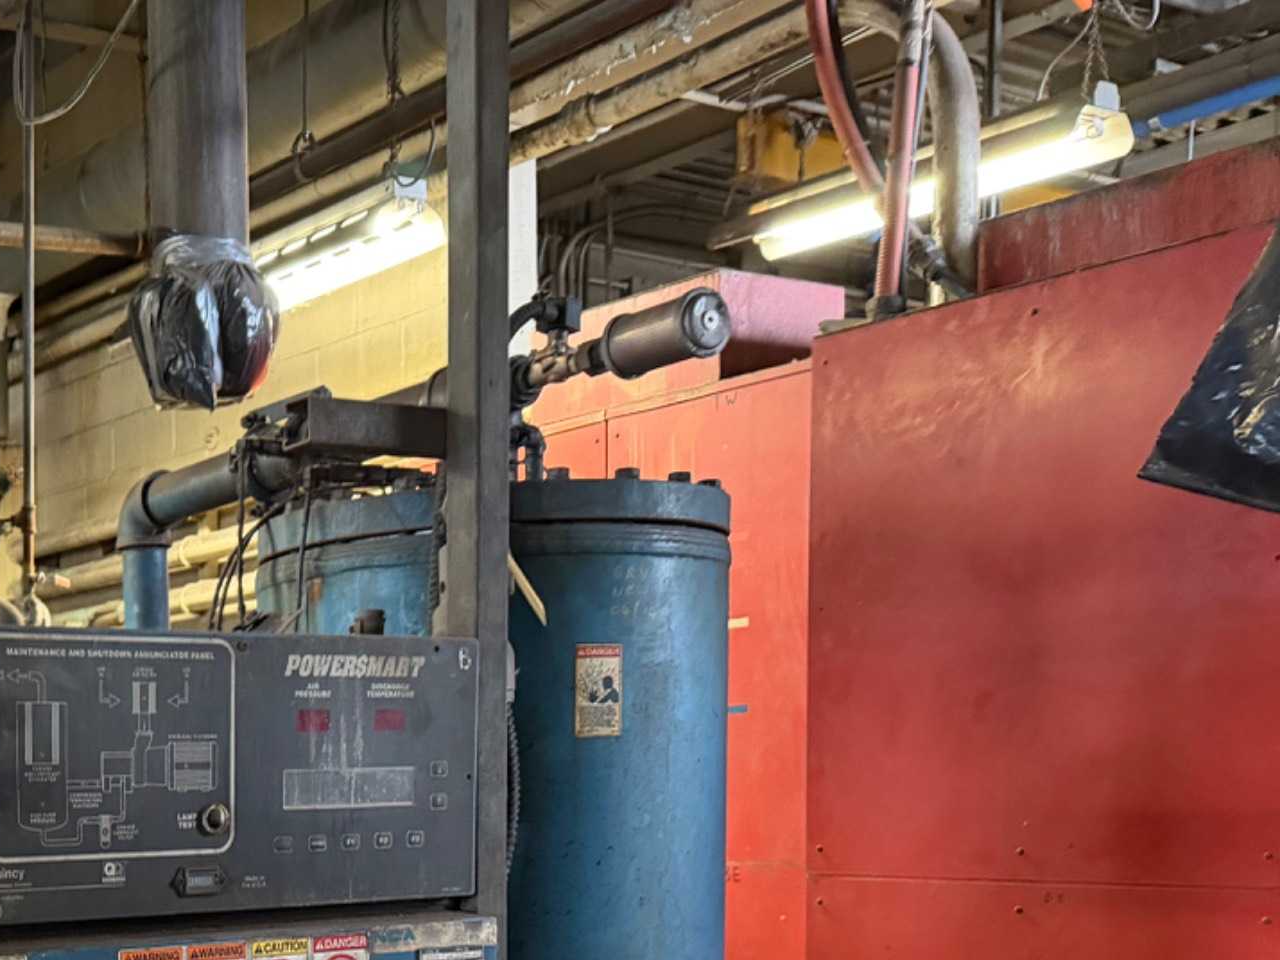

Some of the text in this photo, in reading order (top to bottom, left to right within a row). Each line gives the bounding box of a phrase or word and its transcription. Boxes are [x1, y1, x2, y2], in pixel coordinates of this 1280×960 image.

[6, 648, 66, 657] MAINTENANCE
[68, 650, 86, 658] AND
[87, 650, 131, 659] SHUTDOWN
[191, 652, 215, 660] PANEL
[295, 689, 332, 698] PRESSURE
[367, 689, 415, 698] TEMPERATURE
[177, 812, 197, 821] LAMP
[179, 821, 196, 829] TEST
[264, 941, 308, 953] CAUTION
[323, 936, 367, 949] DANGER
[198, 947, 244, 960] WARNING
